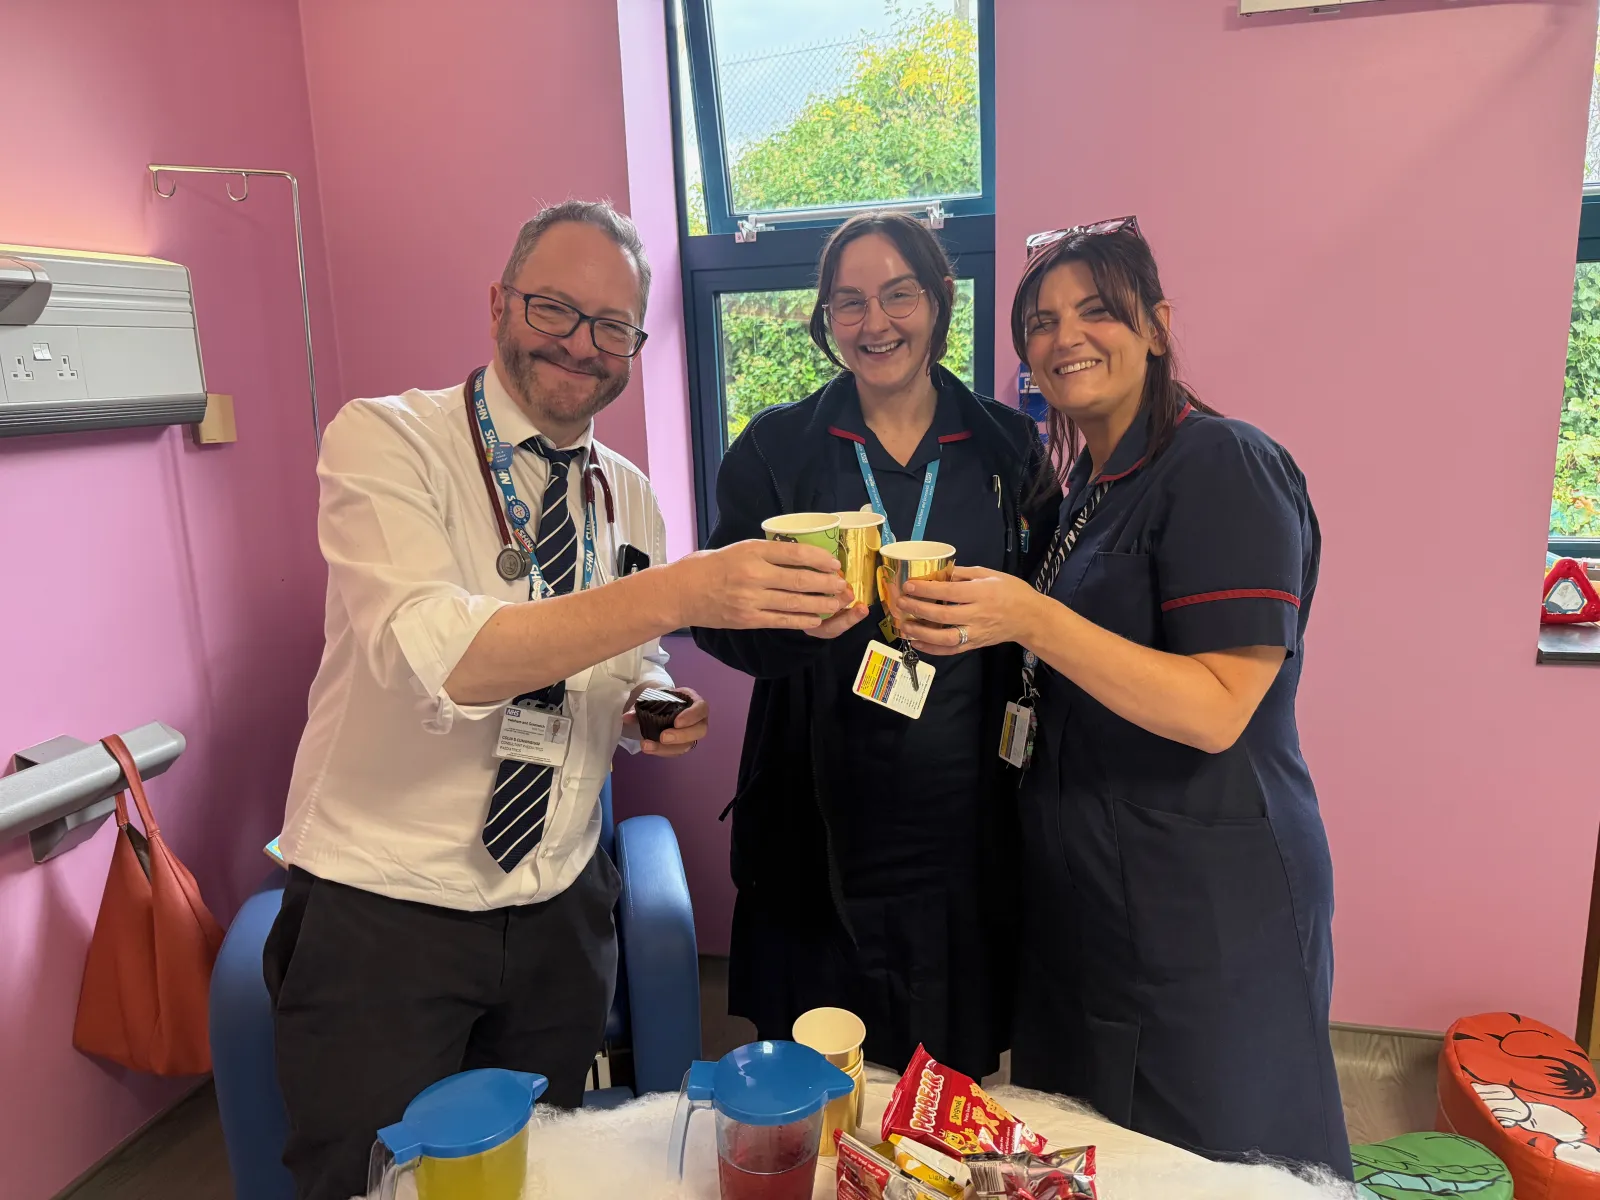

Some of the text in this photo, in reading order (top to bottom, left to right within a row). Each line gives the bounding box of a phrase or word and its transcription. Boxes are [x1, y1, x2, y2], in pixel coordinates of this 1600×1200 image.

[476, 399, 488, 420] NHS
[586, 549, 594, 573] NHS
[952, 1100, 963, 1120] Original
